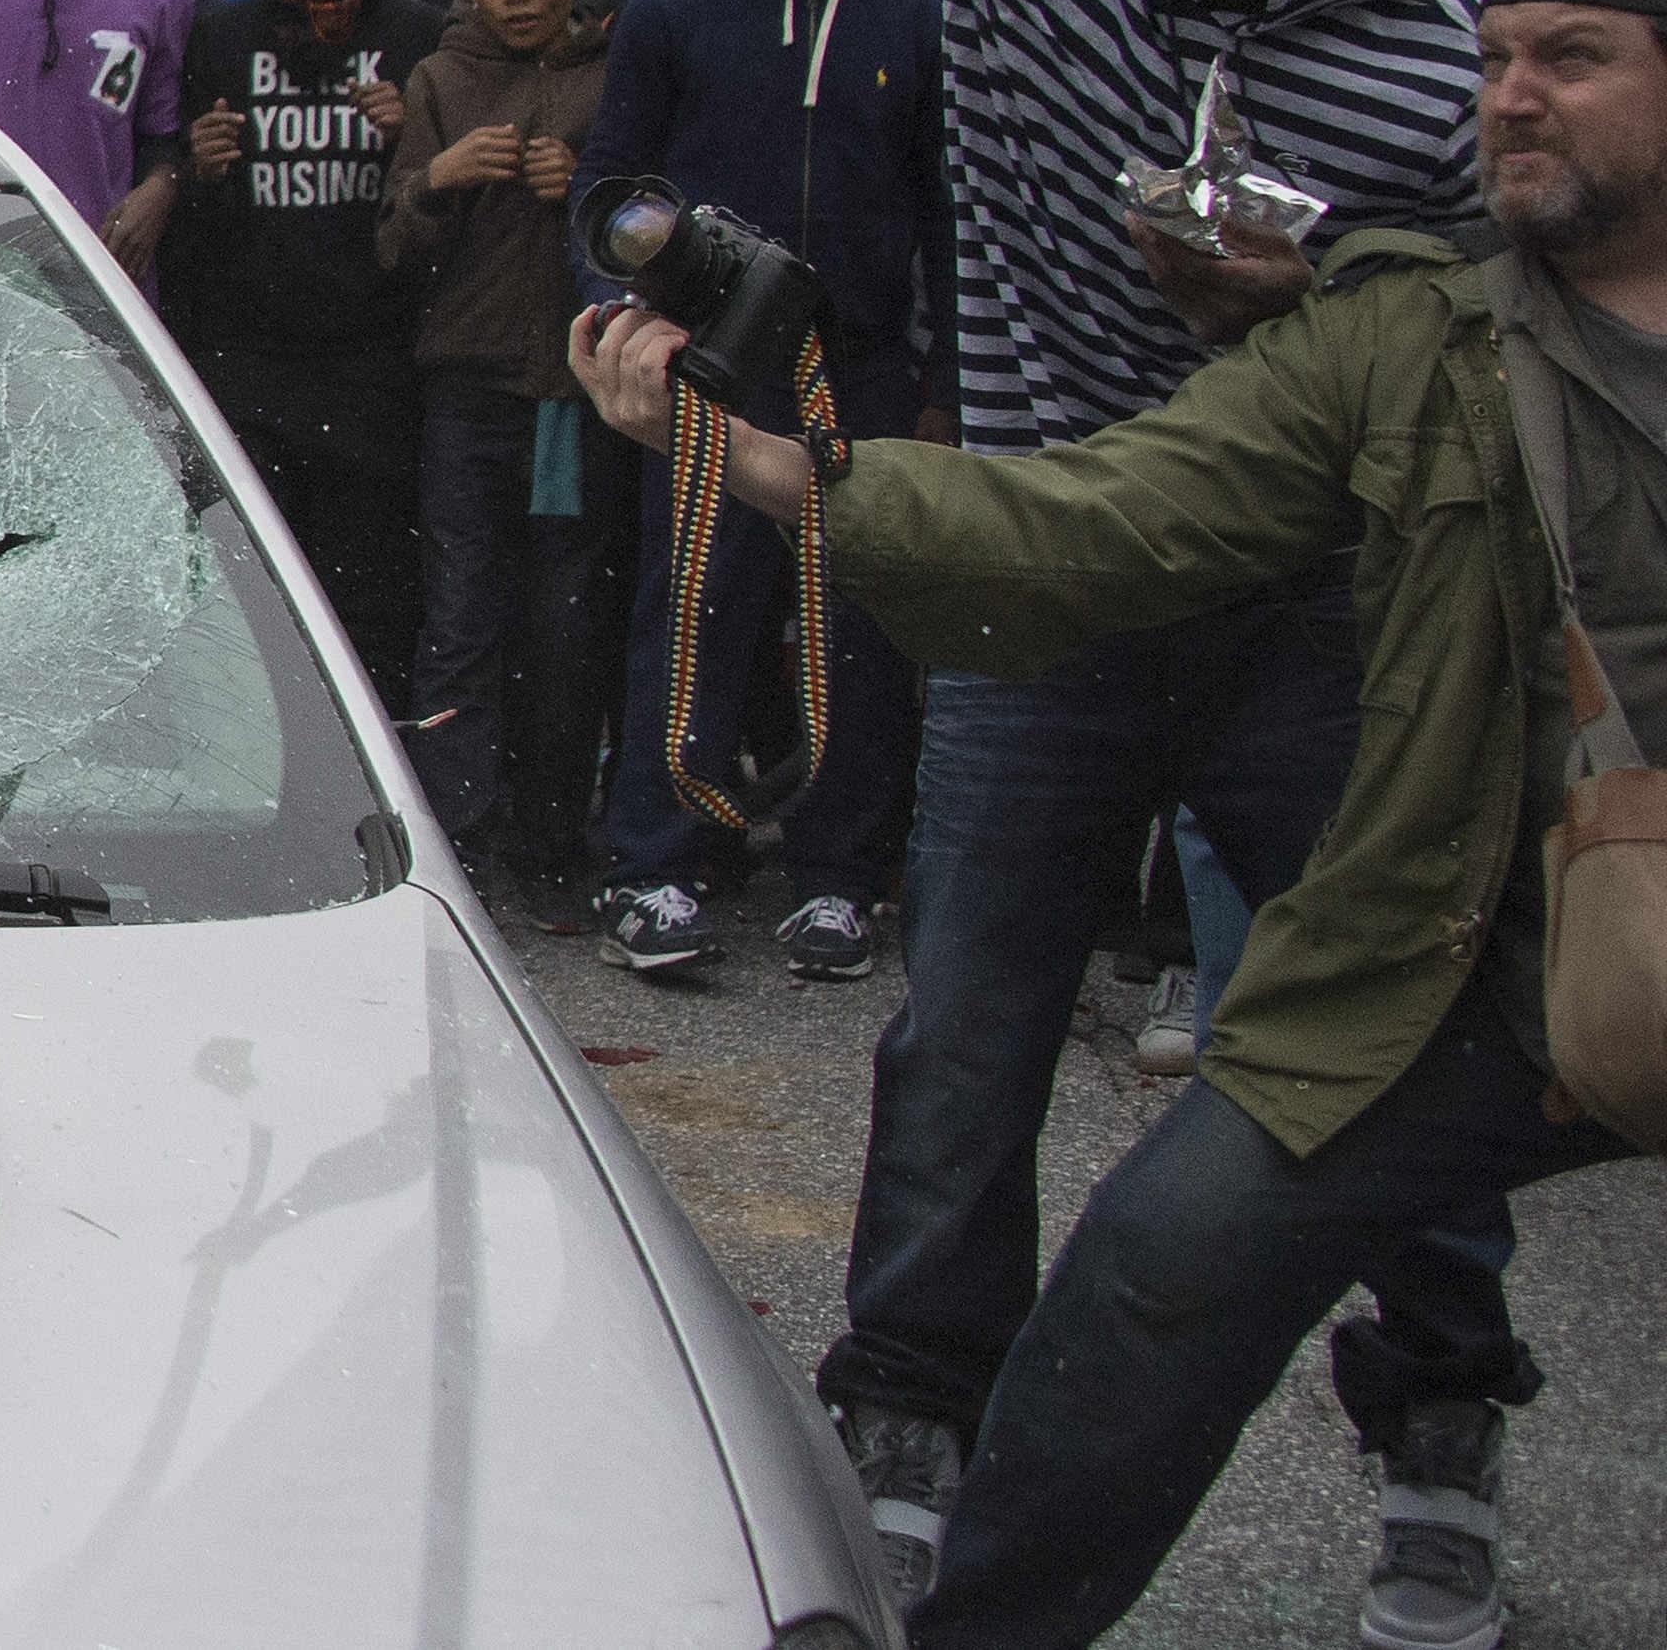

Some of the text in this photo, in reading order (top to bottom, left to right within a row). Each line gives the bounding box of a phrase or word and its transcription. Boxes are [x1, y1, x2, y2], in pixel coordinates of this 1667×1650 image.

[252, 50, 383, 96] BLK
[252, 104, 384, 151] YOUTH
[252, 160, 383, 207] RISING
